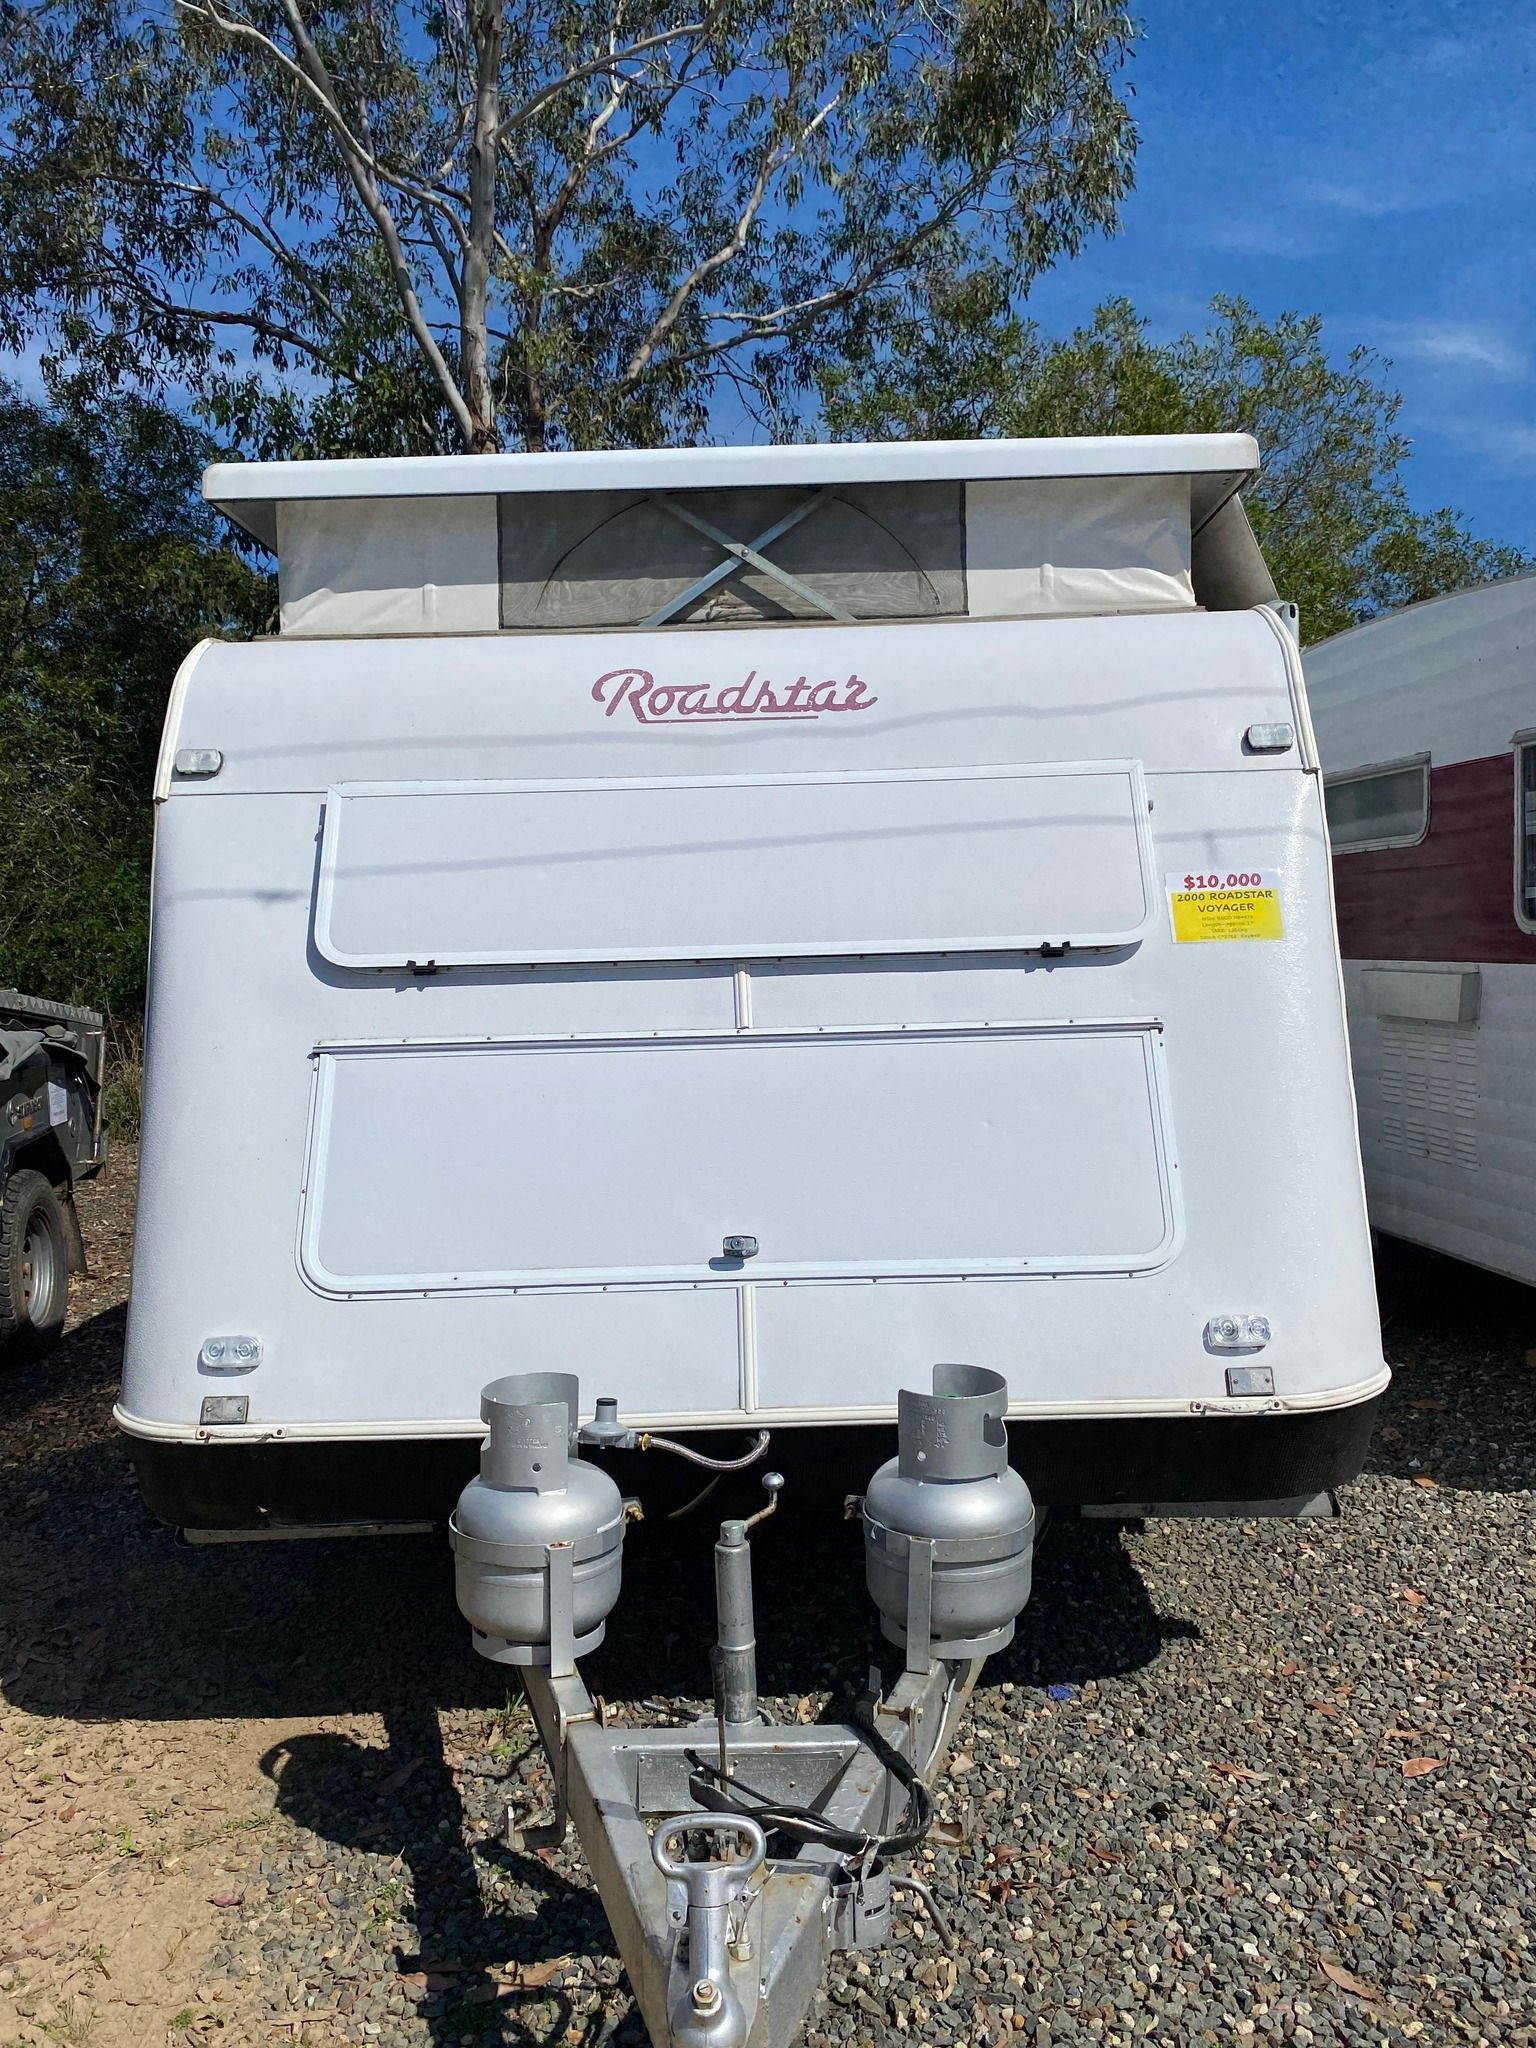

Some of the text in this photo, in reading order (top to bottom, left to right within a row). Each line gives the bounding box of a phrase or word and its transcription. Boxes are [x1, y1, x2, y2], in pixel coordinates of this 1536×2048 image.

[591, 668, 879, 723] Roadstar
[1184, 873, 1262, 891] $10,000
[1177, 890, 1273, 902] 2000 ROADSTAR
[1198, 903, 1255, 913] VOYAGER
